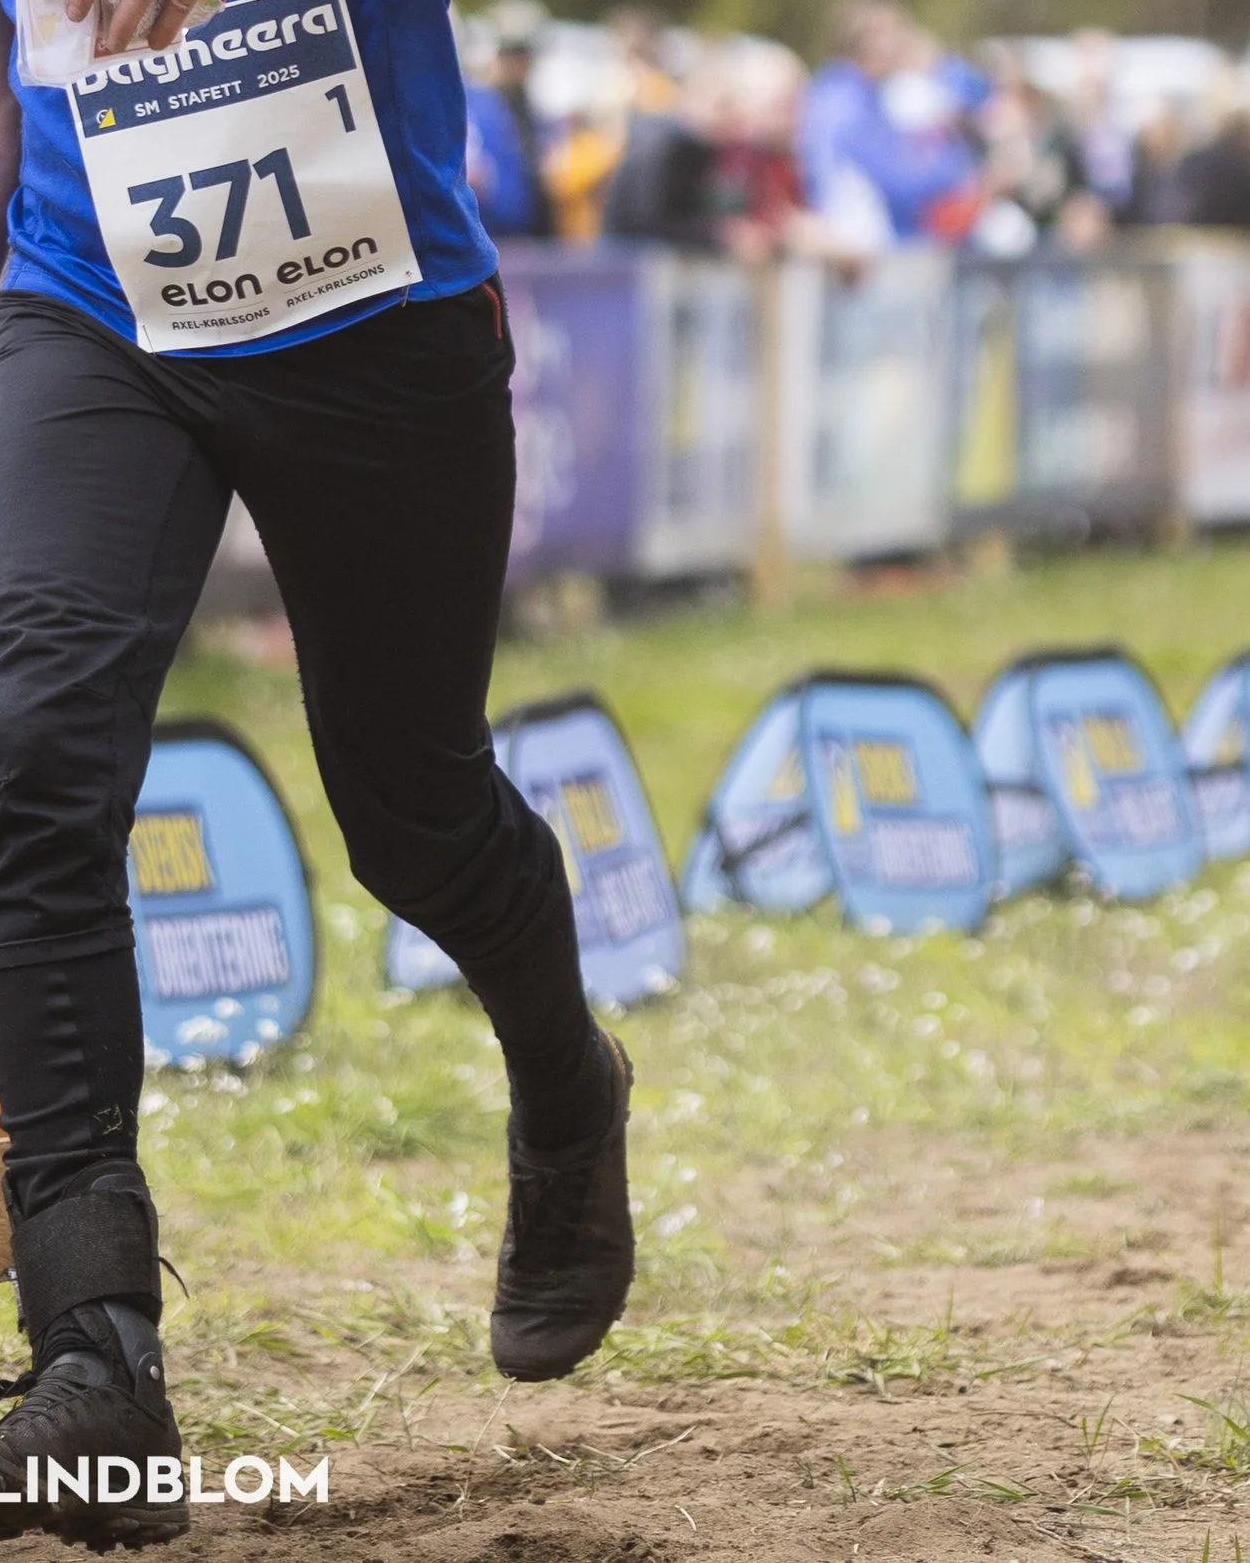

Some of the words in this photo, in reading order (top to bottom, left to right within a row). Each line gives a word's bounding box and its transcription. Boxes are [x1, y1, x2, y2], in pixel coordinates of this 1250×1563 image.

[134, 100, 161, 118] SM
[167, 80, 243, 111] STAFETT
[257, 64, 301, 89] 2025
[324, 84, 357, 134] 1
[127, 147, 312, 269] 371
[286, 264, 386, 309] AXEL-KARLSSONS
[172, 306, 271, 332] AXEL-KARLSSONS
